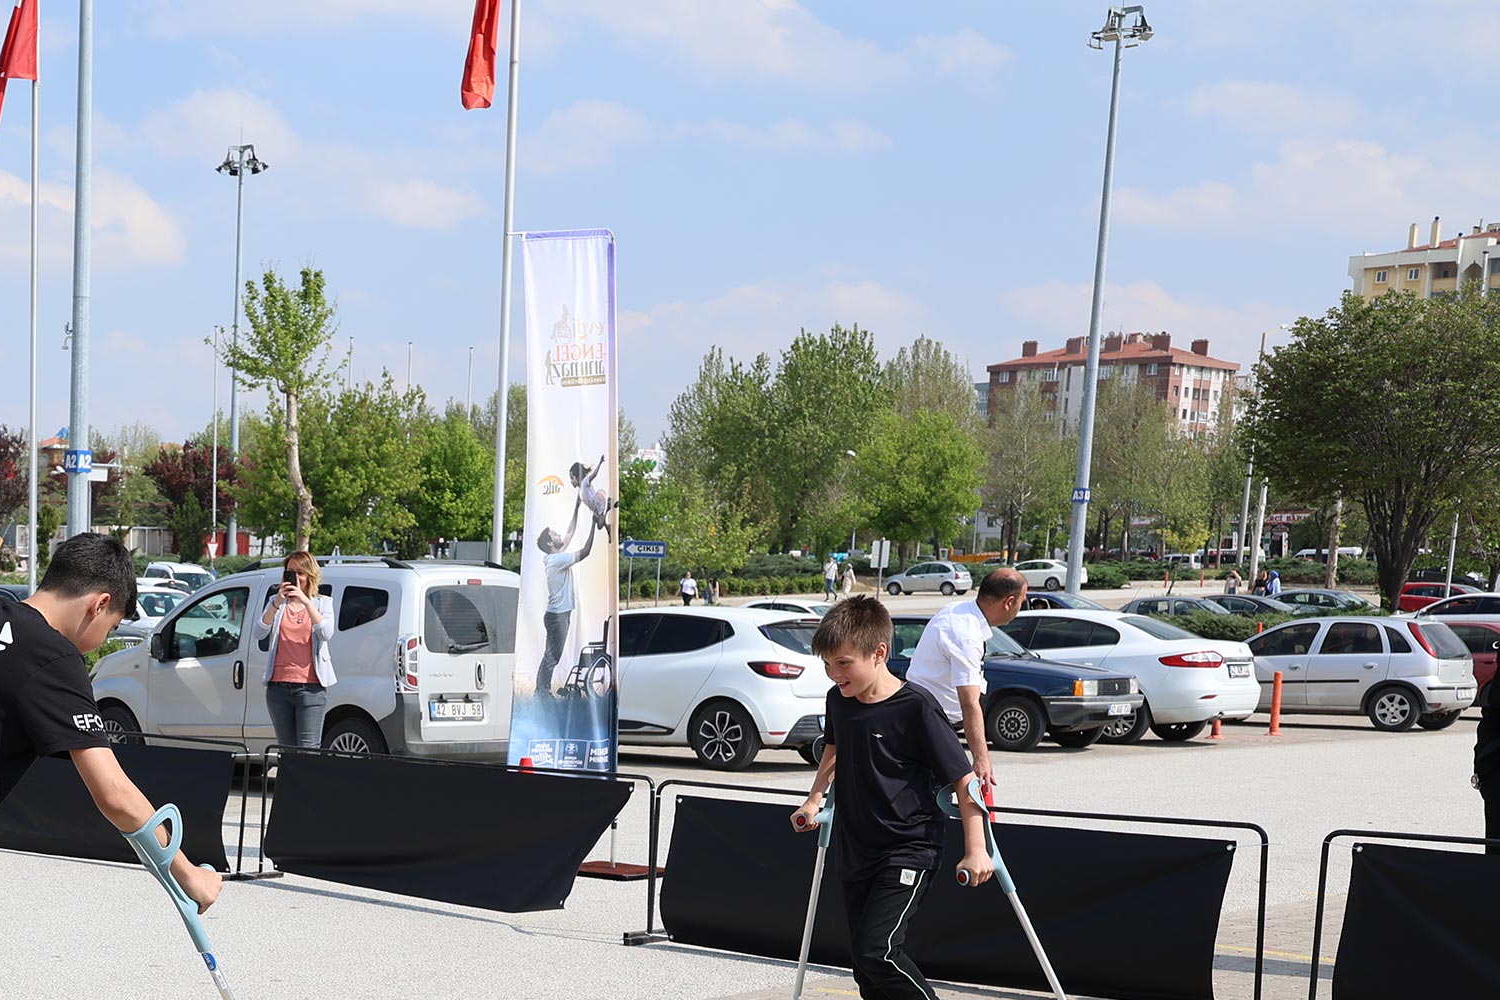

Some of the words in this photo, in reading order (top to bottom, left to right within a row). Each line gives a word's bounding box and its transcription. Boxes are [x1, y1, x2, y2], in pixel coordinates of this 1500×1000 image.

[65, 455, 77, 469] A2
[79, 454, 92, 469] A2
[1073, 490, 1084, 500] A3
[436, 704, 446, 716] 42
[451, 704, 467, 716] BVJ
[471, 704, 481, 716] 58
